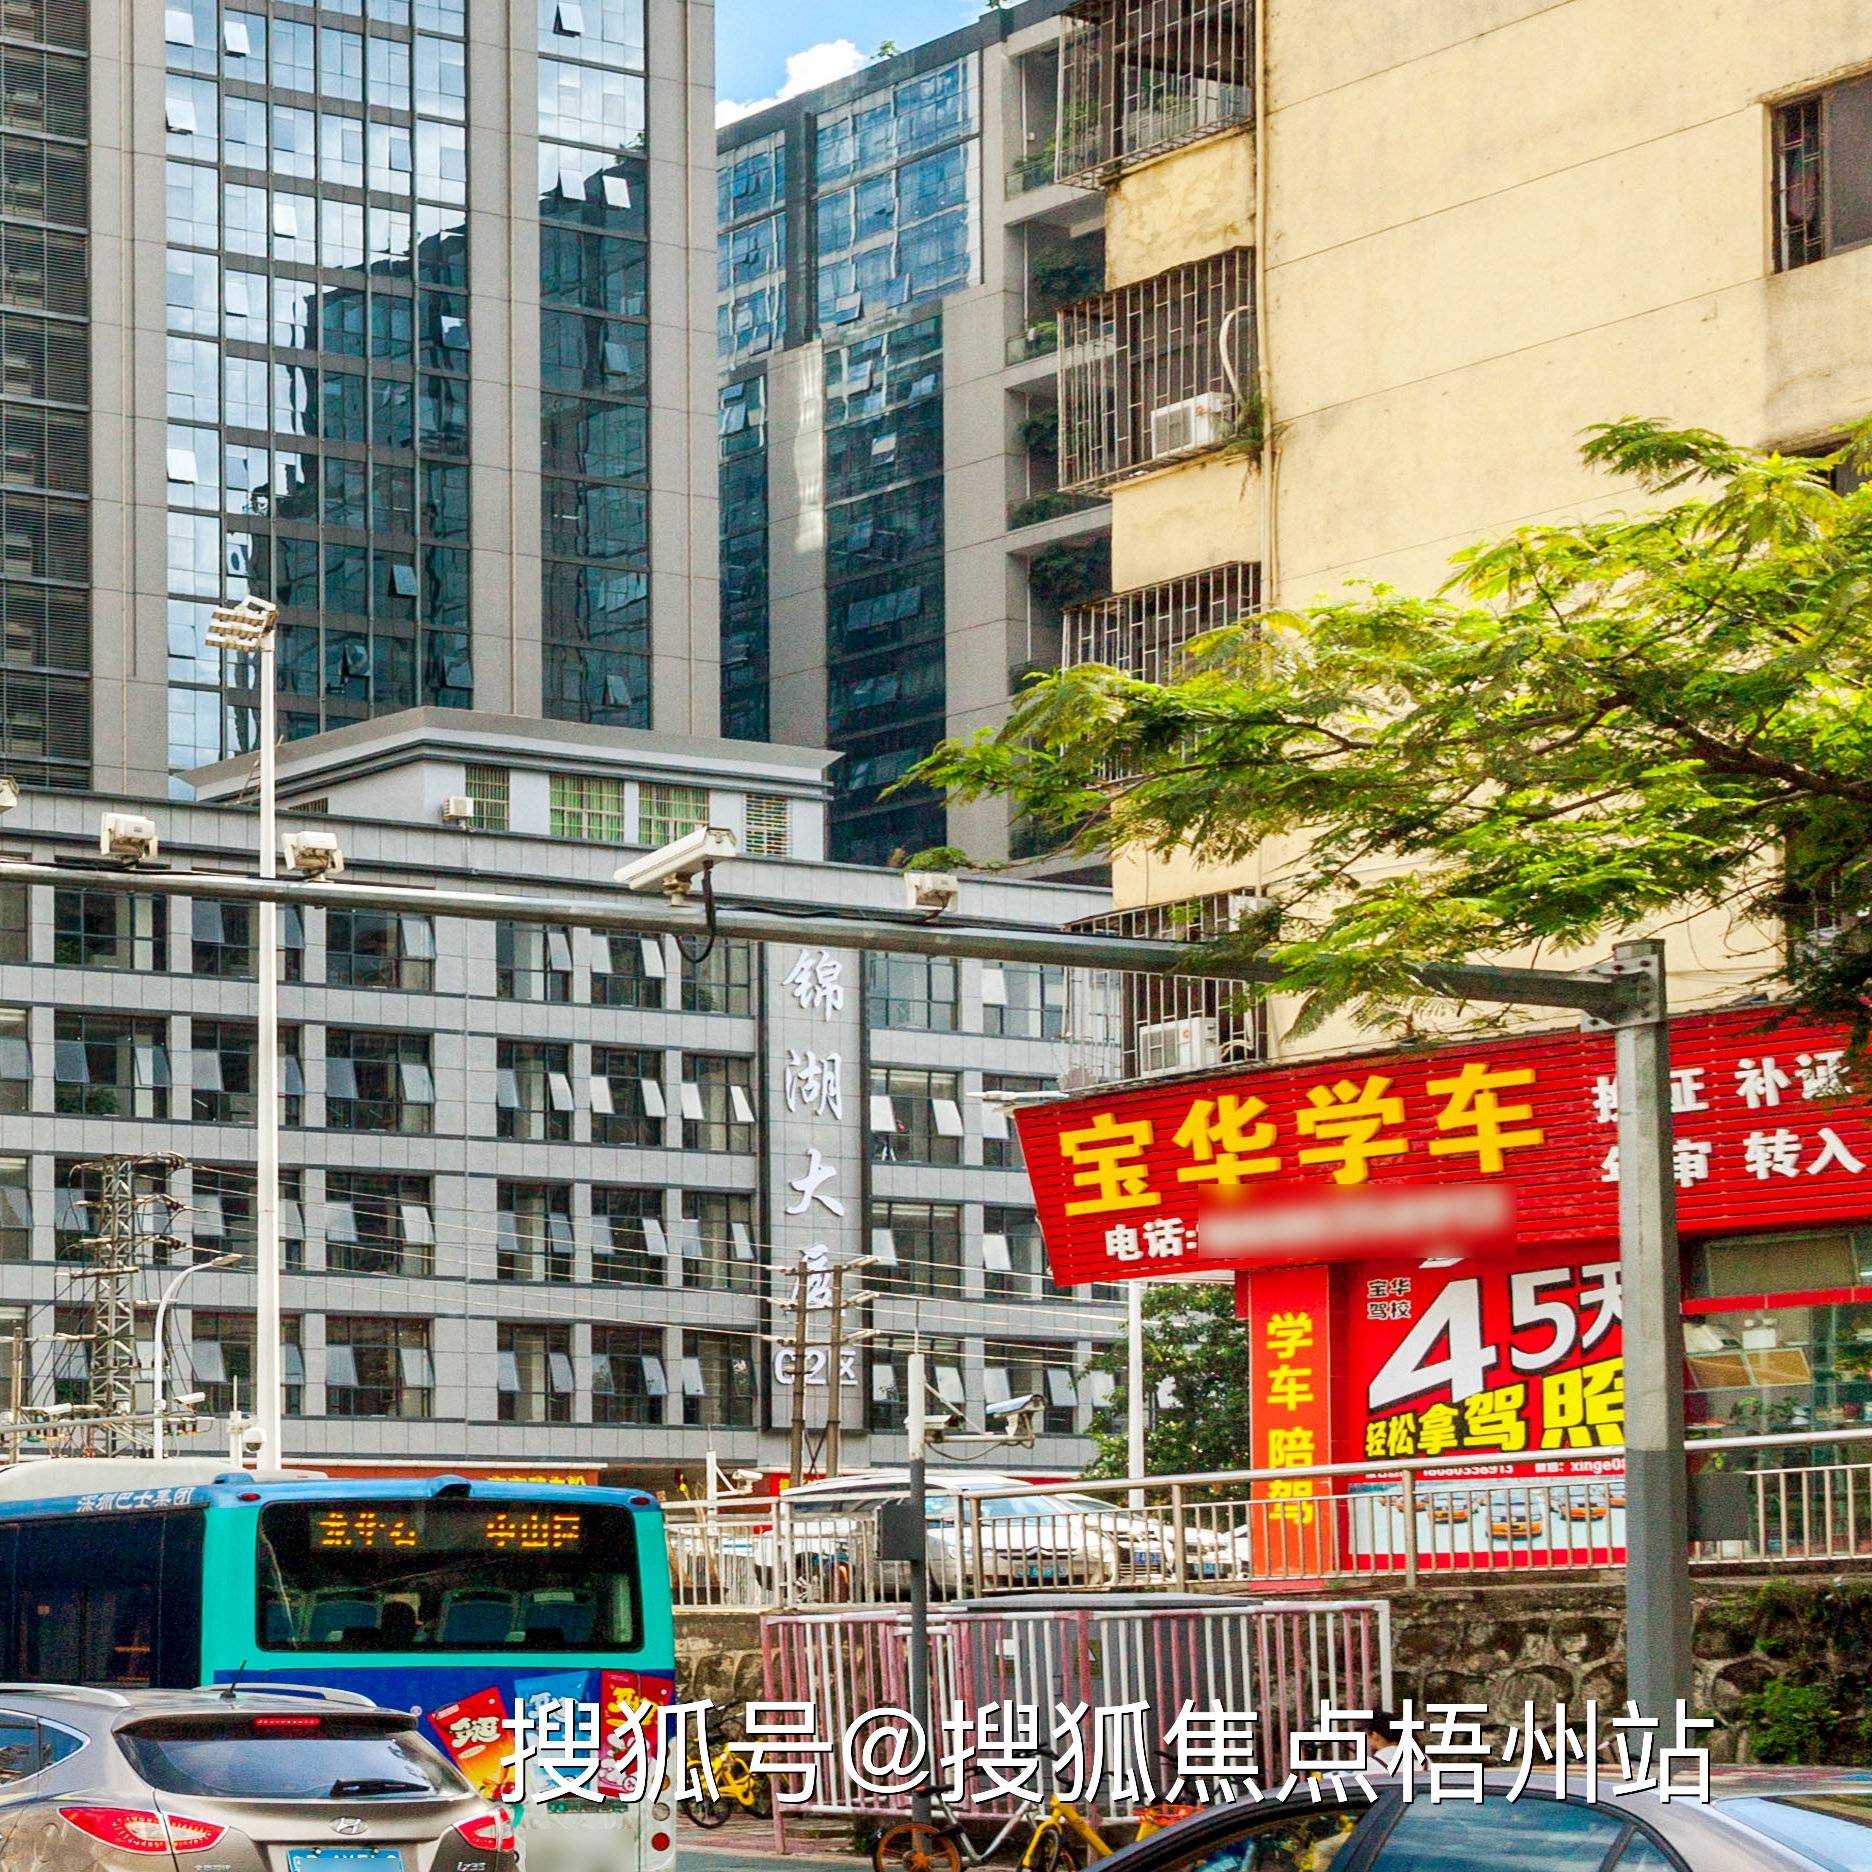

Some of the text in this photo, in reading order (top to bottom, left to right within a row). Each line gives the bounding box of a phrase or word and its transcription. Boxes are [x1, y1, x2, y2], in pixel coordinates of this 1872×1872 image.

[1059, 1062, 1545, 1218] 宝华学车
[1742, 1127, 1867, 1180] 转入
[1367, 1278, 1411, 1299] 宝华
[1367, 1301, 1411, 1320] 驾校
[1266, 1313, 1315, 1412] 学车
[1364, 1358, 1625, 1458] 轻松拿驾照
